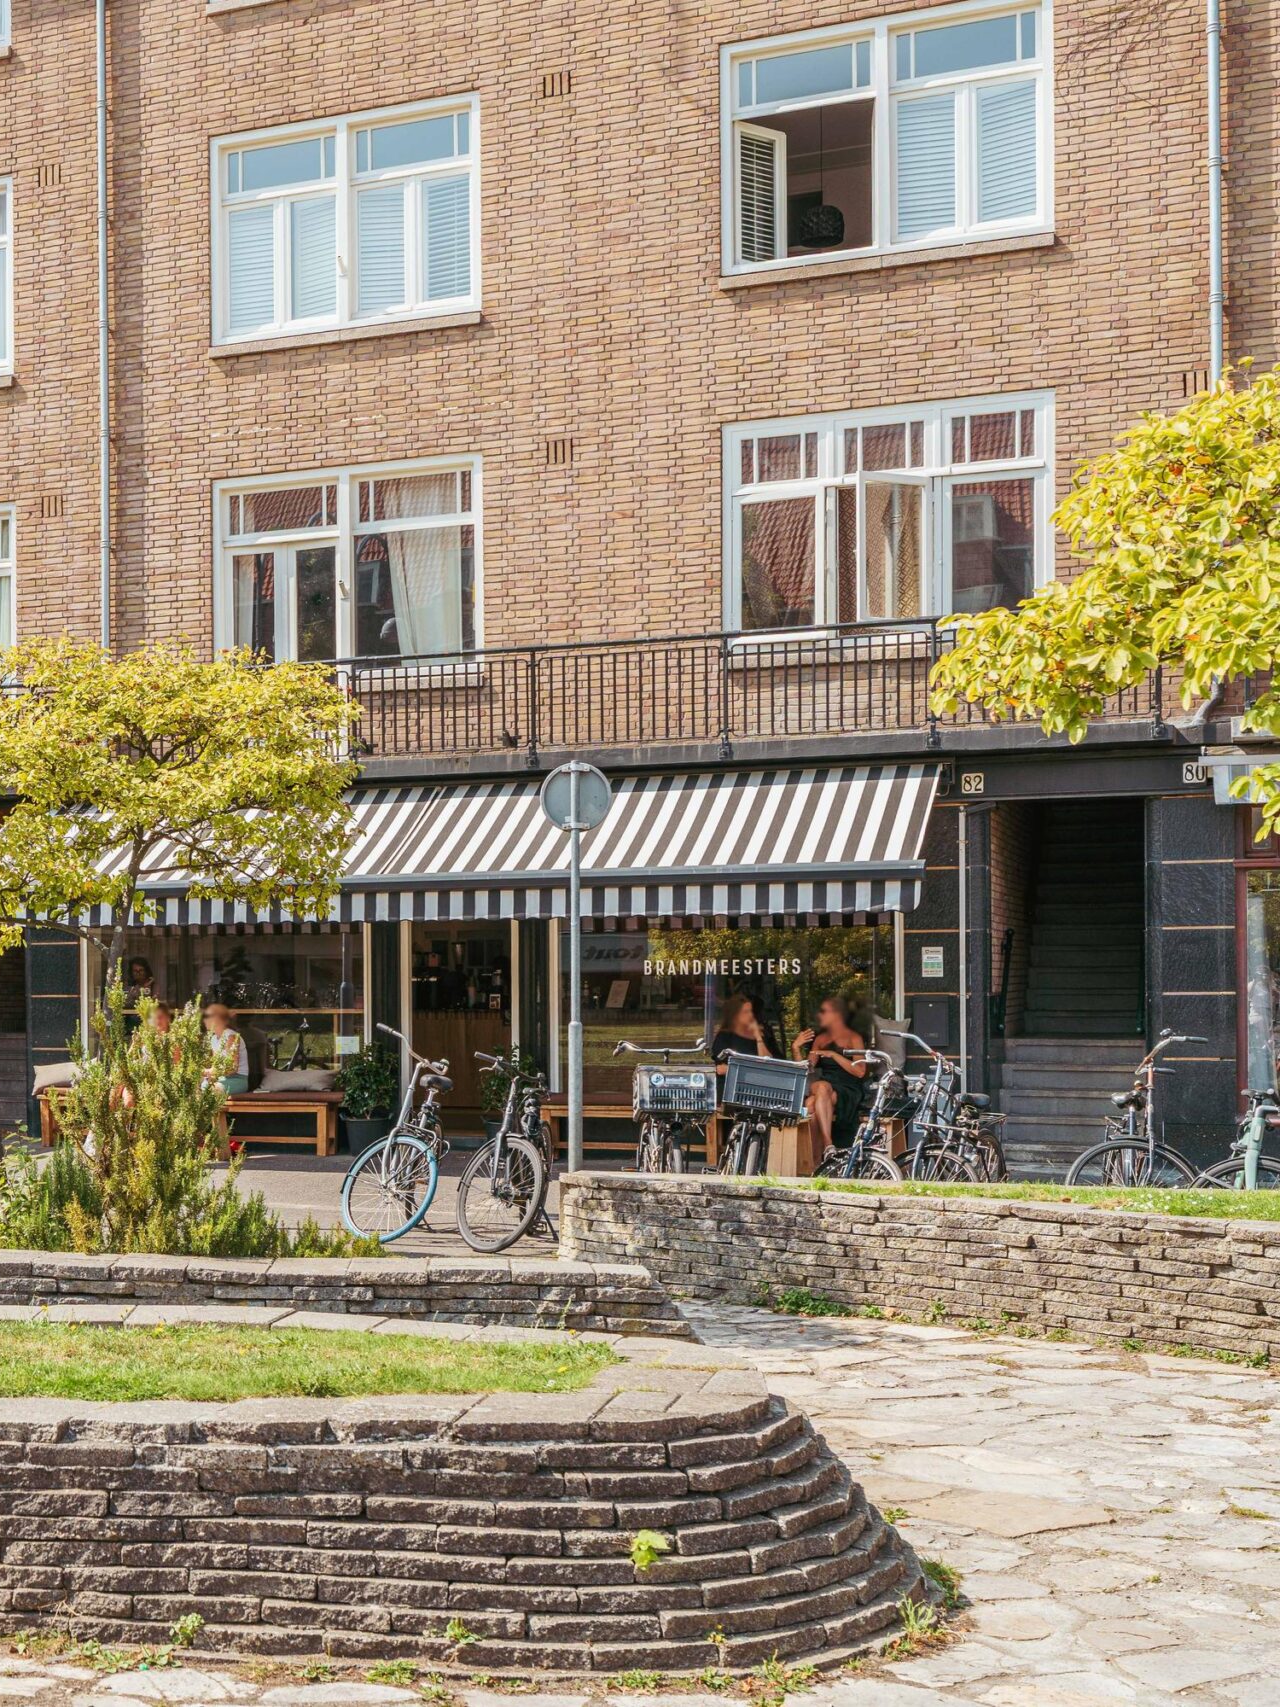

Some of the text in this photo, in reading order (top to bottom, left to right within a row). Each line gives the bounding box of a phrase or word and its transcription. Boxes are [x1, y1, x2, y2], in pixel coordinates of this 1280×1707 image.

[1184, 763, 1205, 781] 80
[963, 775, 983, 792] 82
[643, 958, 802, 976] BRANDMEESTERS
